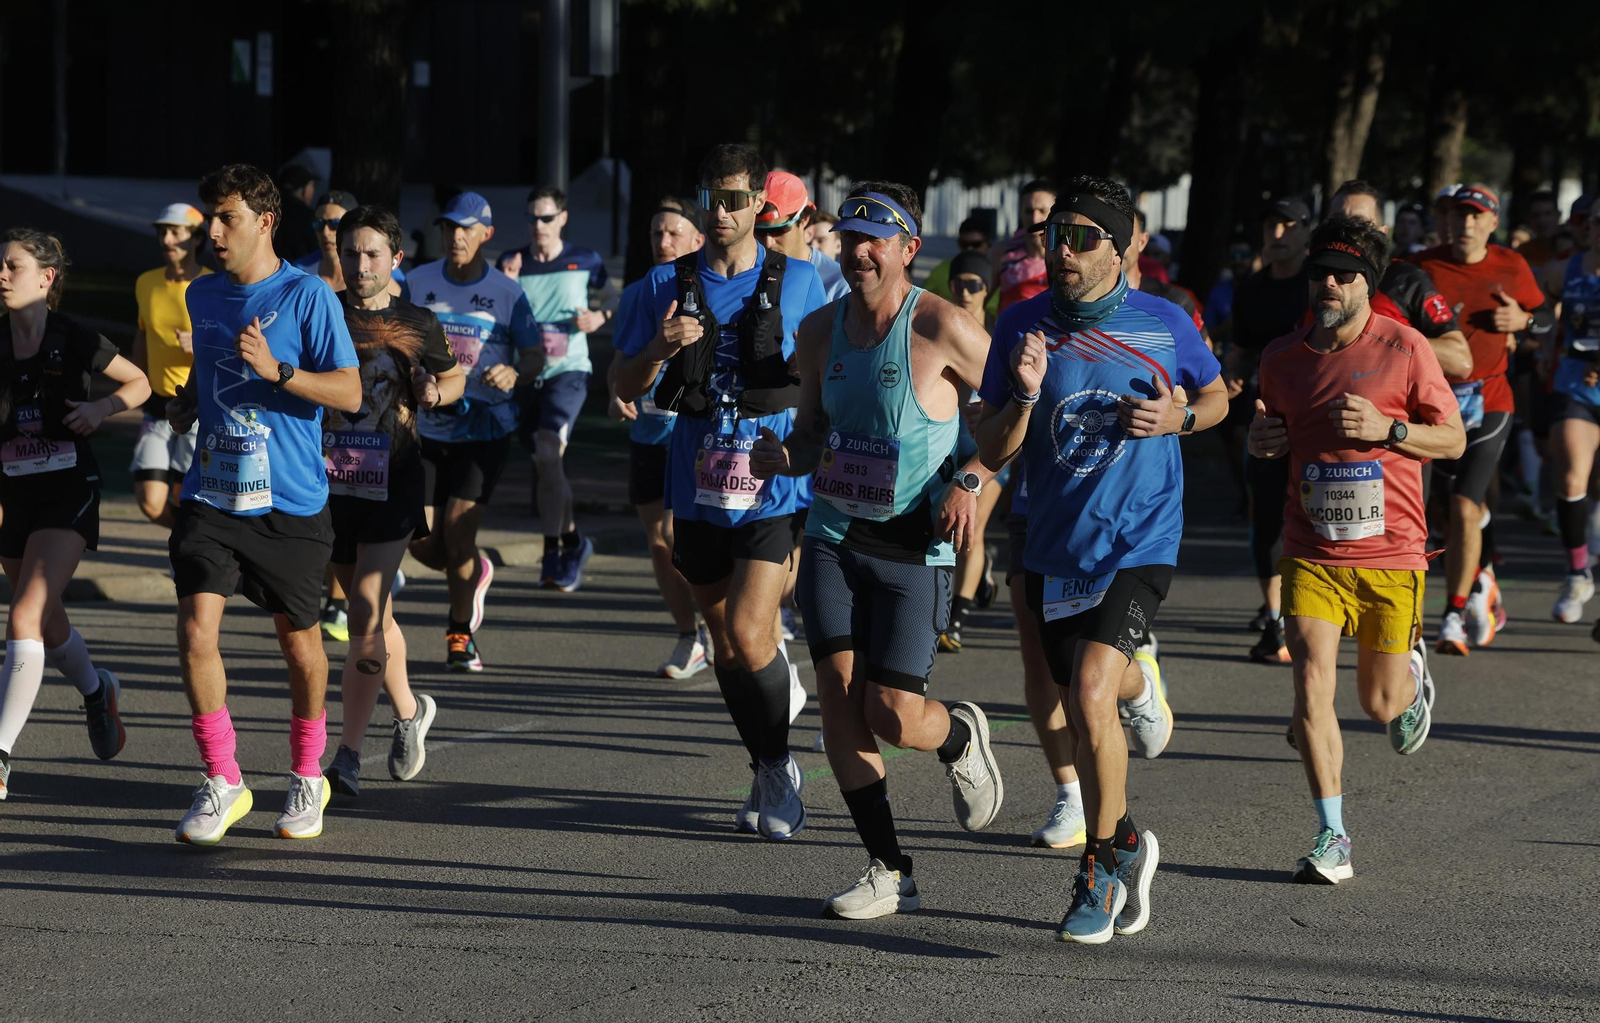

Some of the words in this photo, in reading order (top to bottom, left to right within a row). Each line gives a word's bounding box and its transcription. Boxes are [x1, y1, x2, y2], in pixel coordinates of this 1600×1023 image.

[470, 294, 494, 308] ACS
[340, 436, 380, 446] ZURICH
[1074, 435, 1106, 443] CICLOS
[220, 440, 256, 451] ZURICH
[846, 438, 889, 454] ZURICH
[220, 461, 239, 473] 5762
[340, 456, 360, 466] 9225
[717, 460, 738, 470] 9067
[844, 462, 867, 476] 9513
[1325, 466, 1372, 478] ZURICH
[202, 476, 218, 490] FER
[220, 479, 269, 494] ESQUIVEL
[700, 472, 757, 491] PUJADES
[813, 476, 854, 495] ALORS
[858, 484, 894, 503] REIFS
[1325, 490, 1355, 500] 10344
[1358, 506, 1384, 520] L.R.
